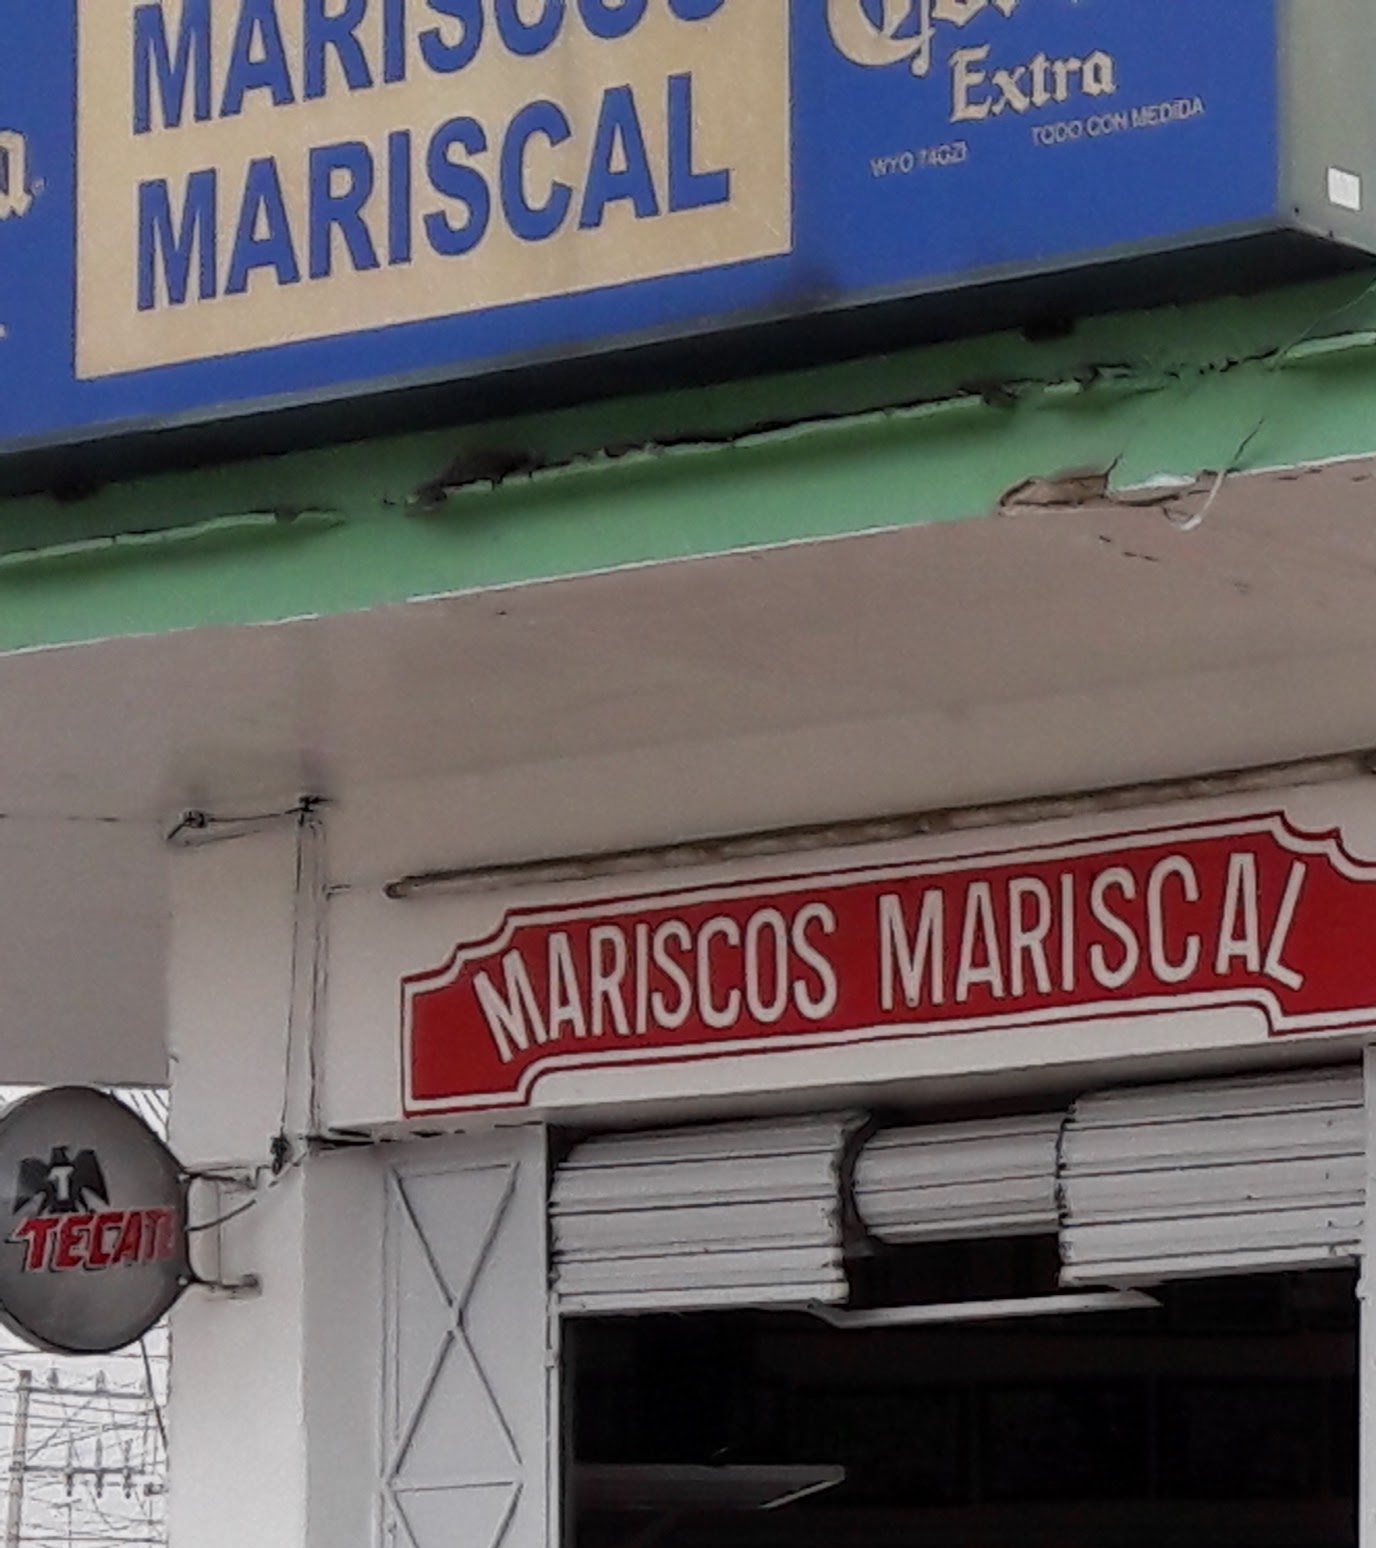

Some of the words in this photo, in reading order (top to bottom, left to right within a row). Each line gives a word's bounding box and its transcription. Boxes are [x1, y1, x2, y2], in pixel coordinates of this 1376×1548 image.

[949, 45, 1118, 123] Extra
[1030, 119, 1082, 146] TODO
[1086, 111, 1129, 138] CON
[136, 71, 732, 311] MARISCAL
[473, 902, 840, 1065] MARISCOS
[876, 850, 1307, 1011] MARISCAL
